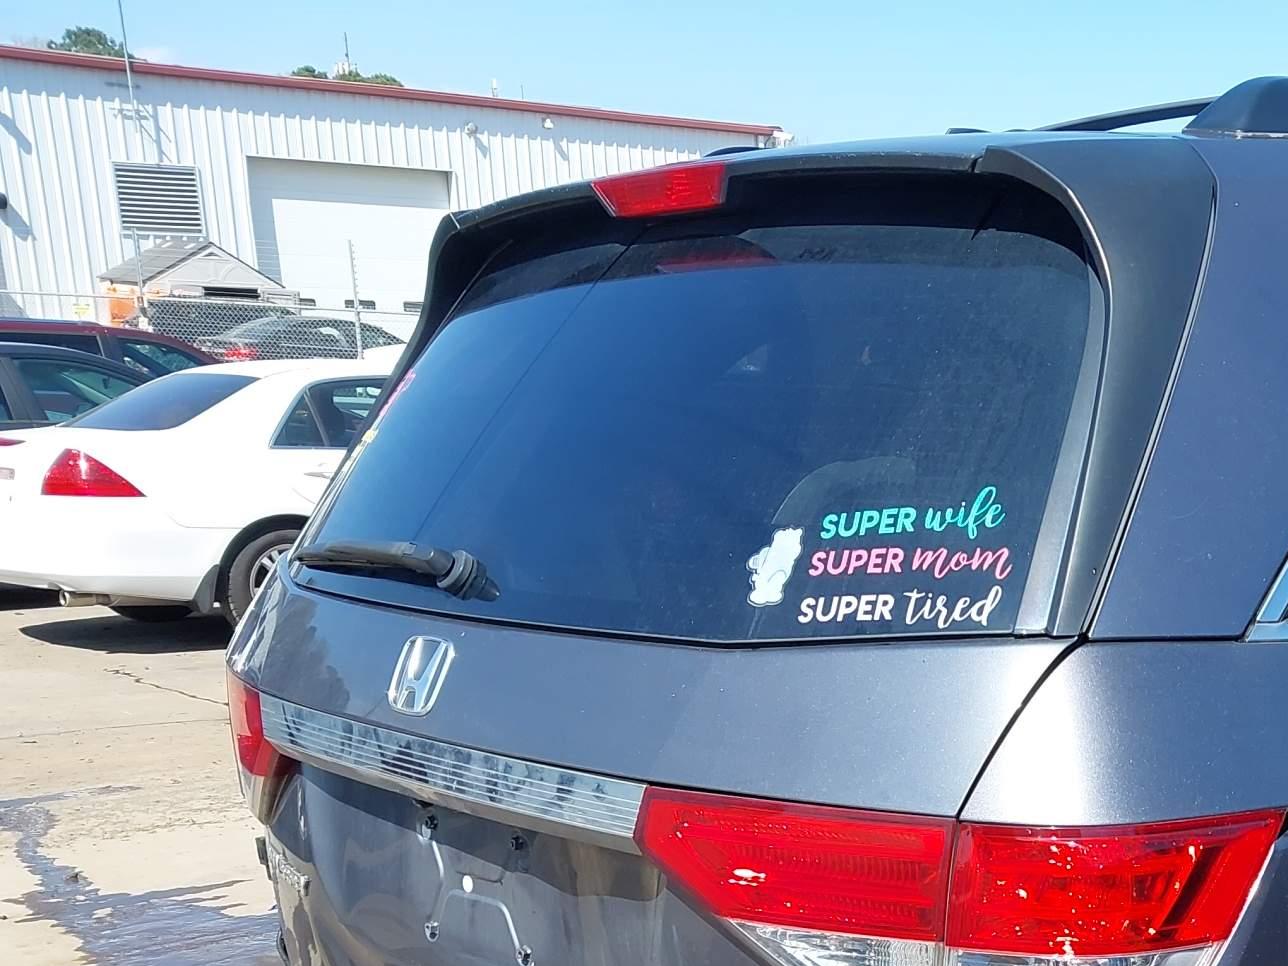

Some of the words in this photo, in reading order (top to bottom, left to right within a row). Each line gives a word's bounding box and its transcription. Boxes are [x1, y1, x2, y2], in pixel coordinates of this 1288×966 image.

[820, 507, 916, 539] SUPER
[924, 486, 1006, 539] wife
[808, 547, 905, 576] SUPER
[911, 547, 1013, 579] mom
[797, 594, 896, 624] SUPER
[902, 585, 1002, 629] tired
